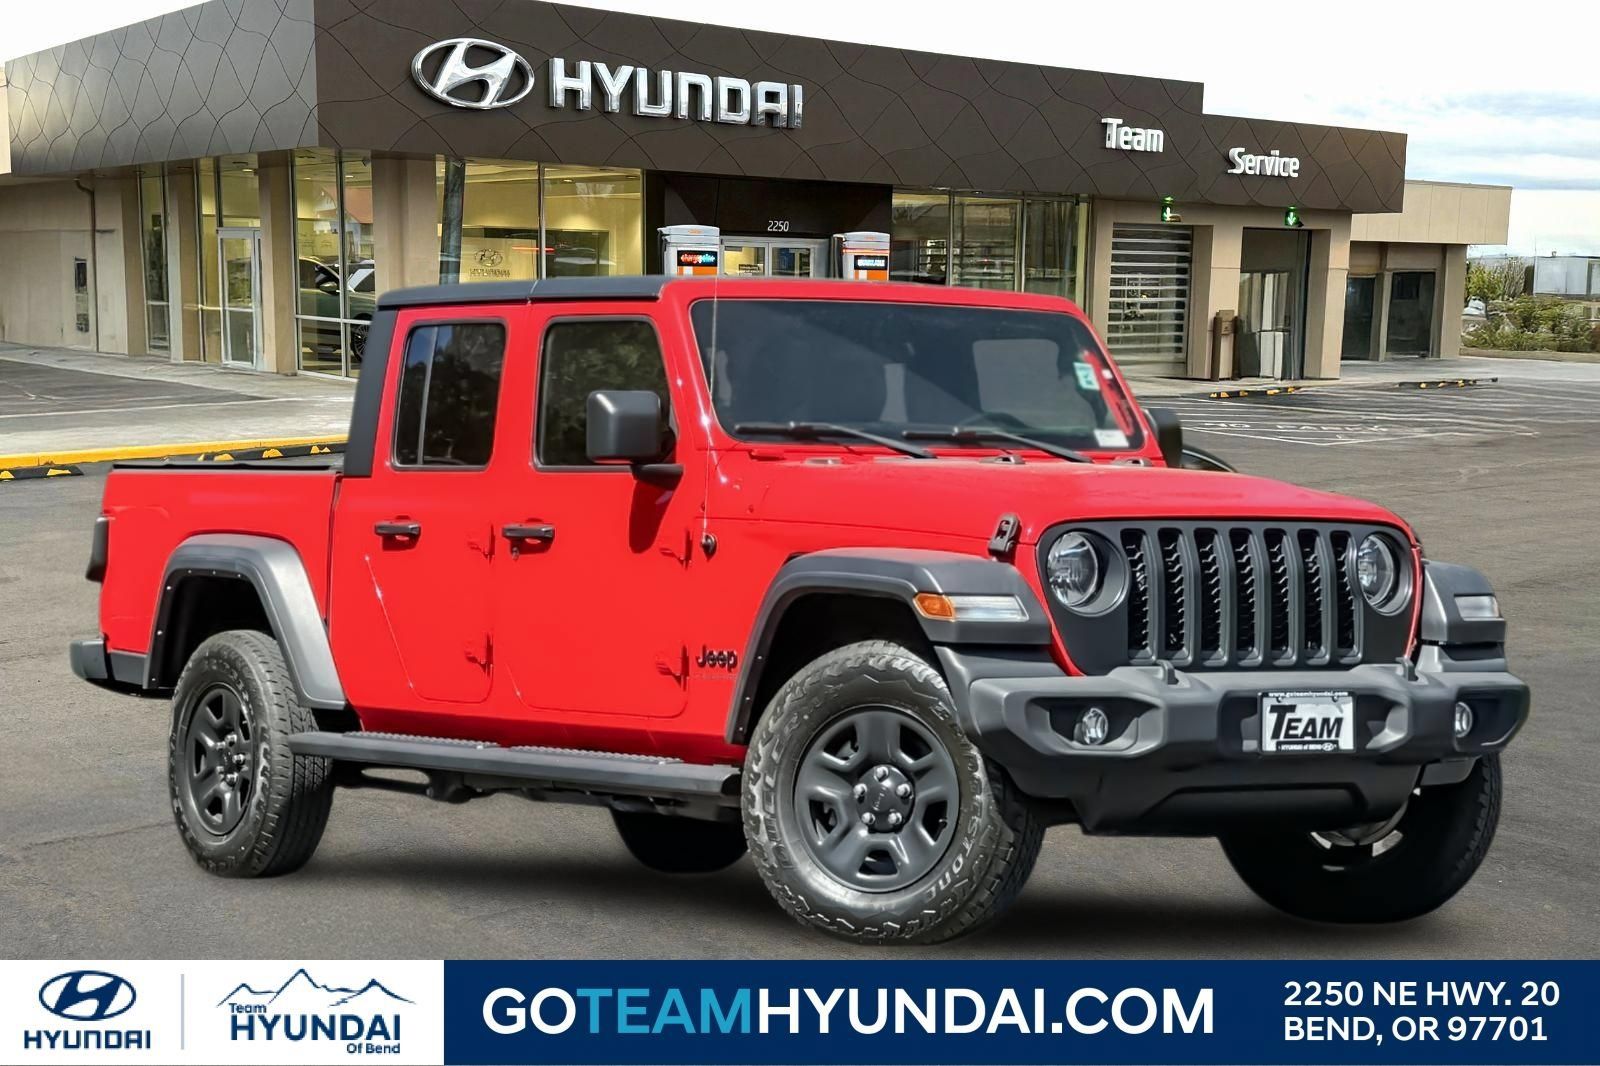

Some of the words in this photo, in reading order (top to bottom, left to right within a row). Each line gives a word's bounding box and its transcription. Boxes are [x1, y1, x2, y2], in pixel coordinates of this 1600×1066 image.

[549, 57, 804, 128] HYUNDAI
[1101, 117, 1165, 153] Team
[1227, 146, 1300, 178] Service
[767, 220, 790, 232] 2250
[695, 645, 738, 673] Jeep
[1269, 704, 1344, 740] TEAM
